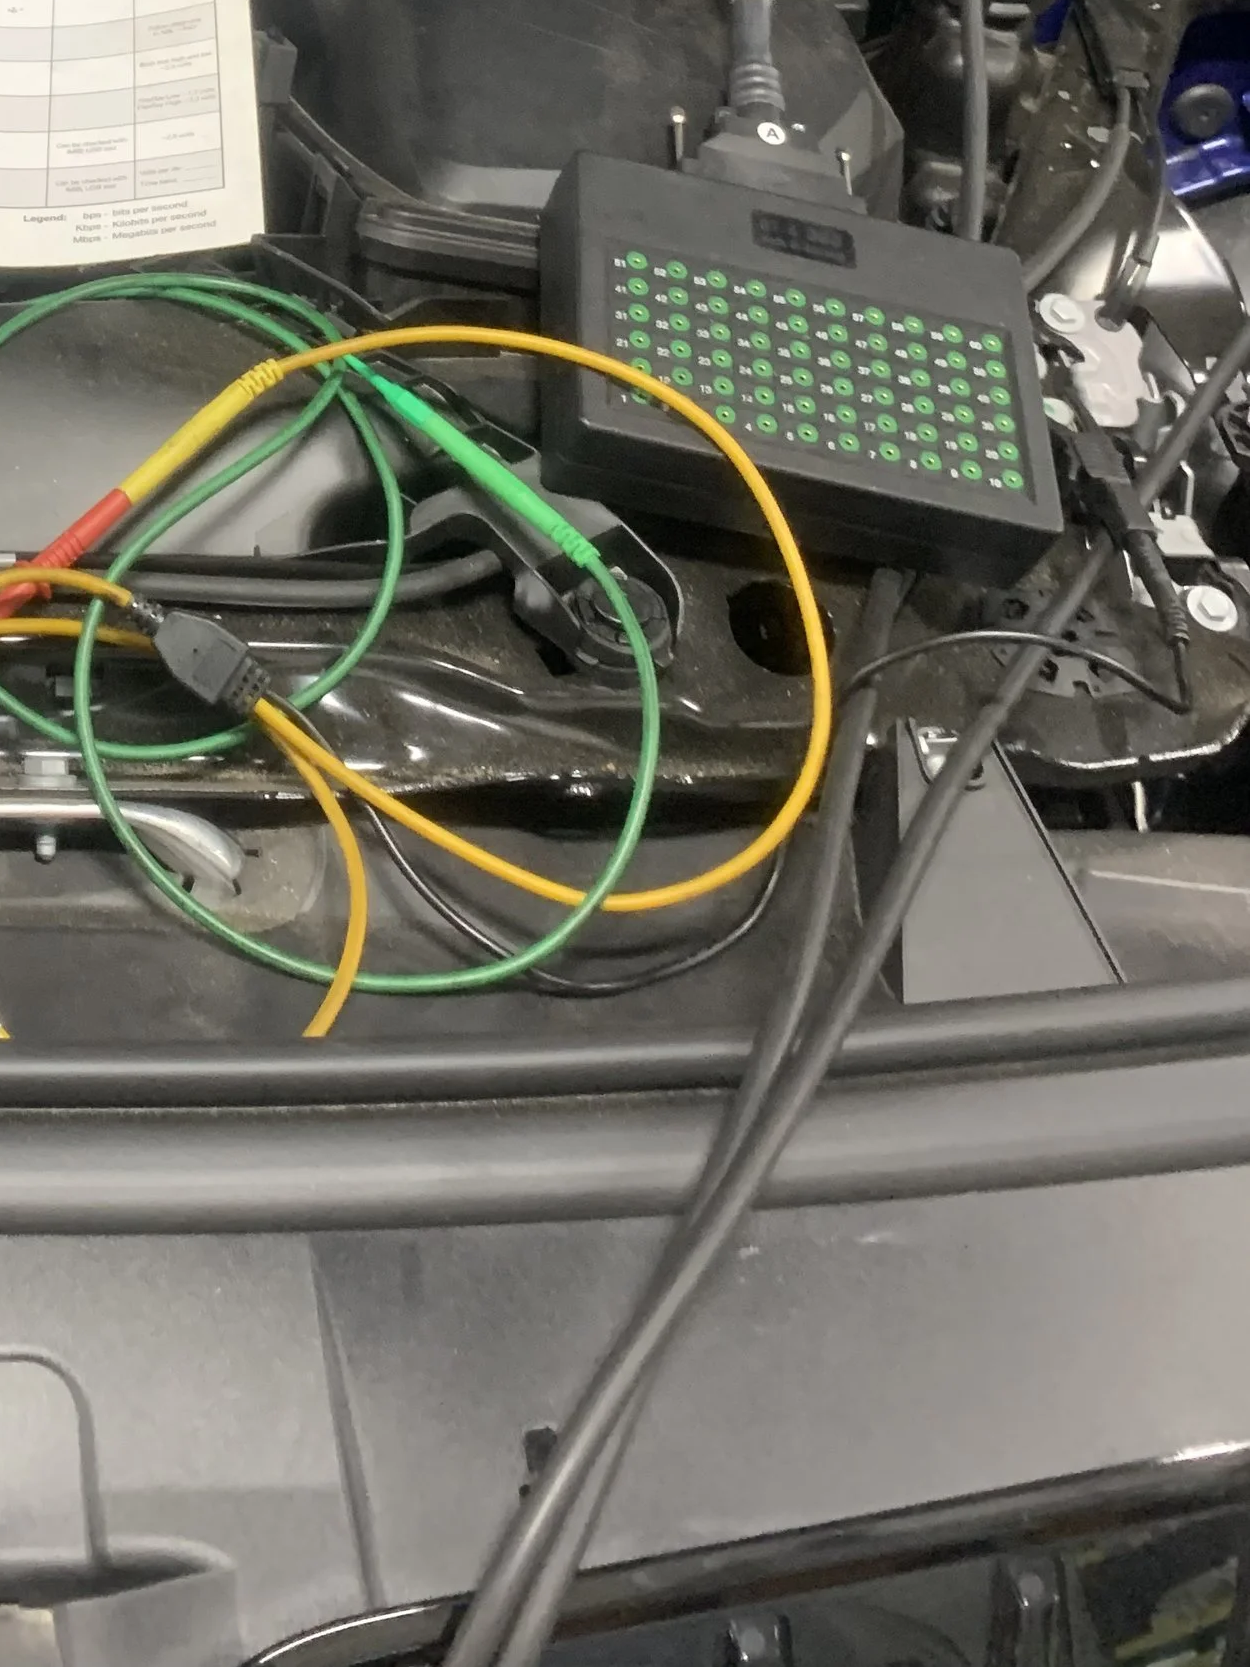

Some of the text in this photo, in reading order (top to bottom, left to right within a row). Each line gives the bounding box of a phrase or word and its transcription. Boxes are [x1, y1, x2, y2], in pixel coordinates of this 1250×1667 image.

[766, 127, 780, 140] A
[23, 200, 188, 223] Legend: bps bits per second
[75, 209, 207, 232] Kbps Kilobits per second
[73, 219, 217, 244] Mbps Megabits per second
[614, 285, 627, 294] 41
[614, 311, 628, 320] 31
[615, 338, 629, 348] 21
[700, 385, 713, 395] 13
[621, 394, 628, 403] 1
[869, 450, 877, 459] 7
